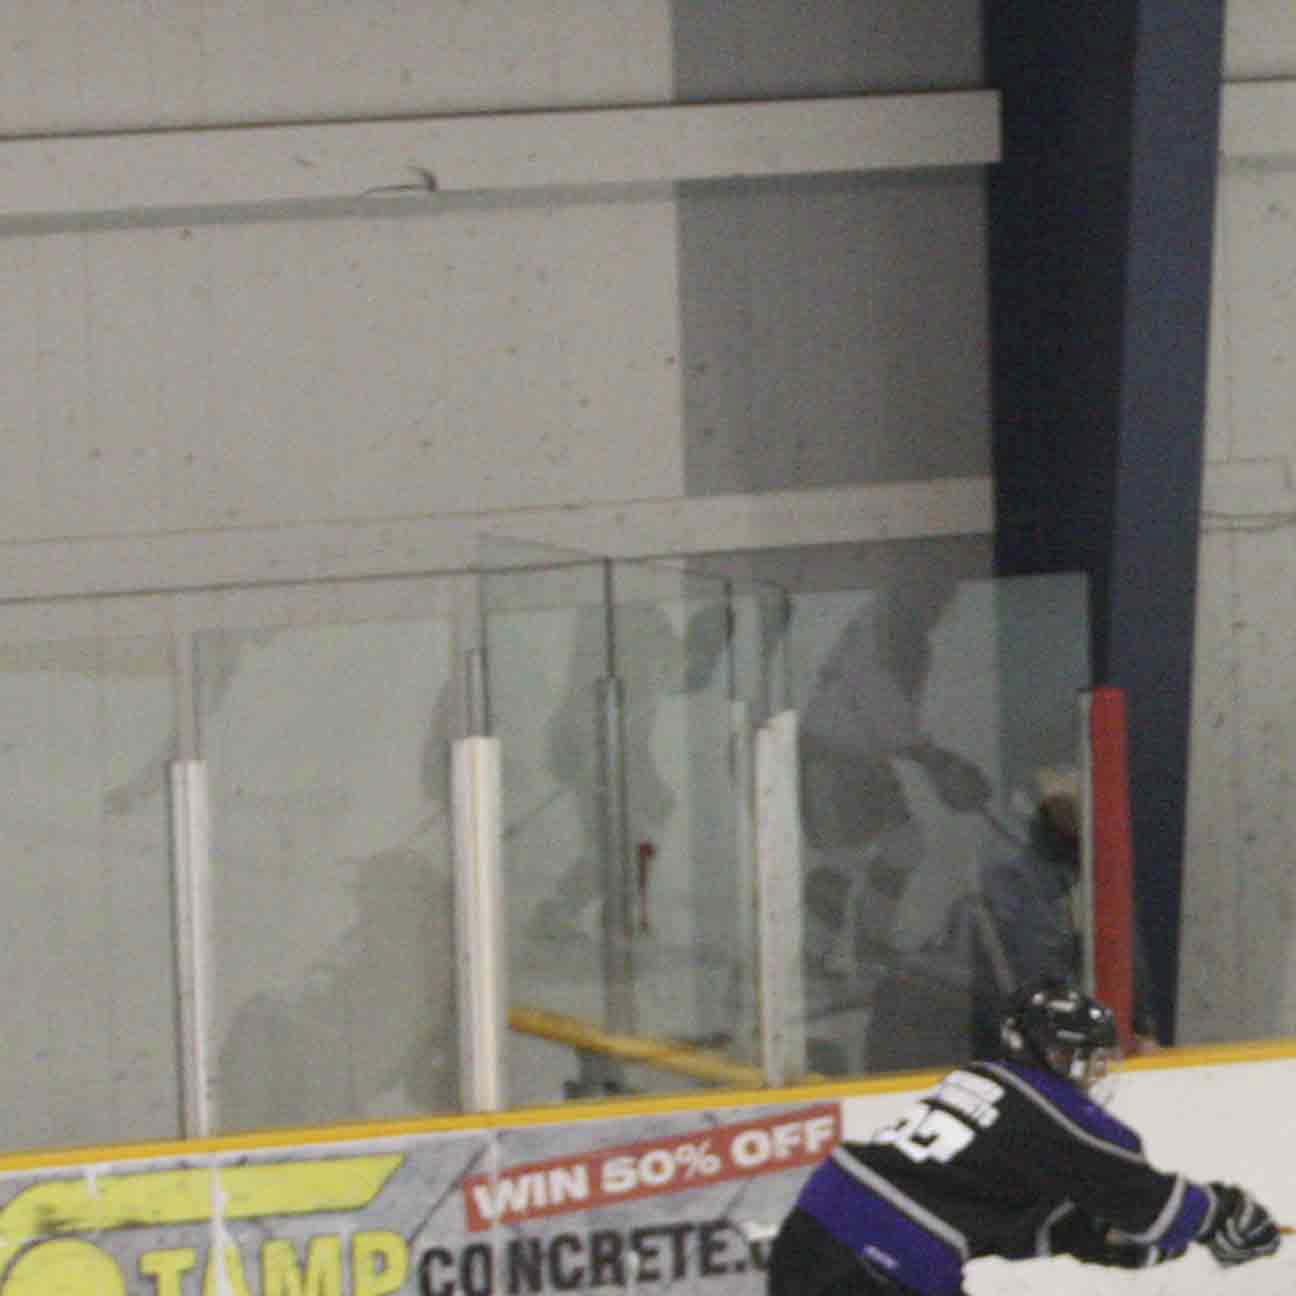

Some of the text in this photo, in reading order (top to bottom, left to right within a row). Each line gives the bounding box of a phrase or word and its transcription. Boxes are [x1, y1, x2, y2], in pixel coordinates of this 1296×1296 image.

[472, 1115, 837, 1221] WIN 50% OFF
